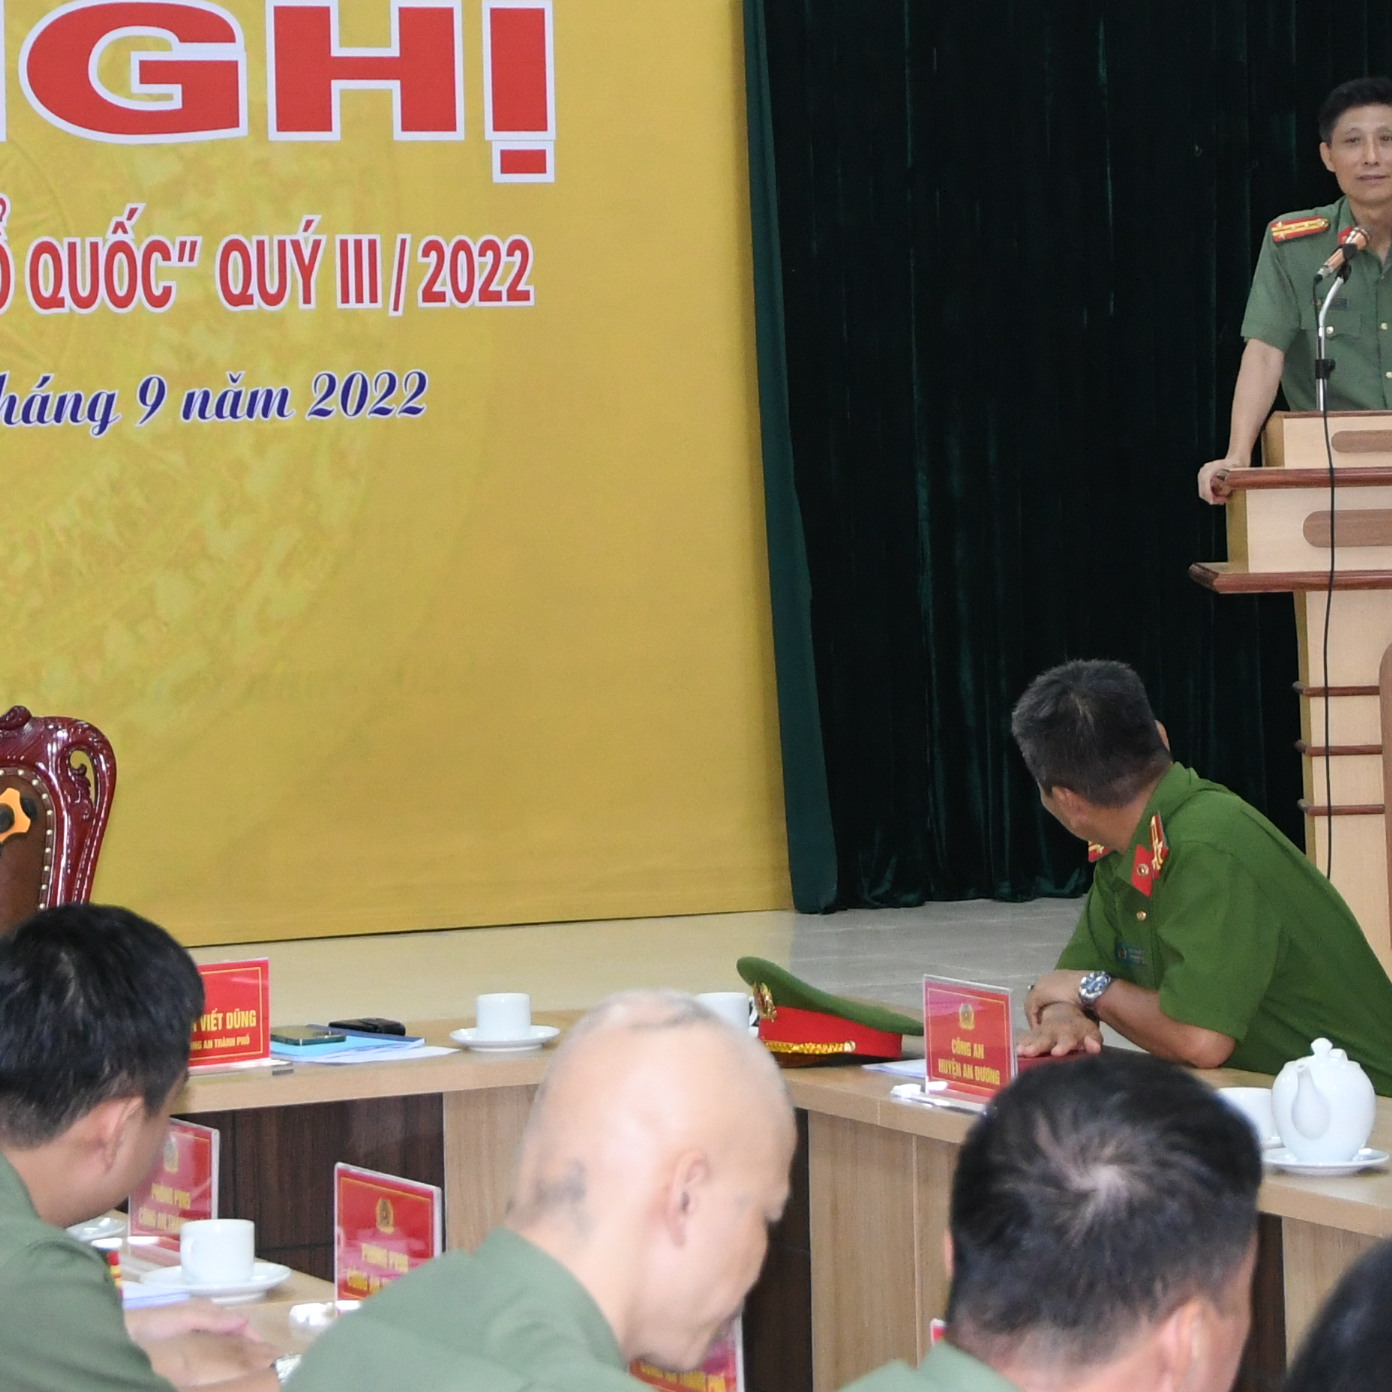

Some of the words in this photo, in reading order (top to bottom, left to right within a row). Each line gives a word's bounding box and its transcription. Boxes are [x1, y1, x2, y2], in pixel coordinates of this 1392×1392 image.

[216, 217, 324, 309] QUÝ
[338, 238, 380, 308] III
[390, 236, 406, 316] /
[420, 236, 533, 306] 2022
[137, 374, 166, 424] 9
[180, 374, 292, 423] năm
[308, 369, 428, 419] 2022
[200, 1008, 223, 1031] VIẾT
[226, 1009, 256, 1029] DŨNG
